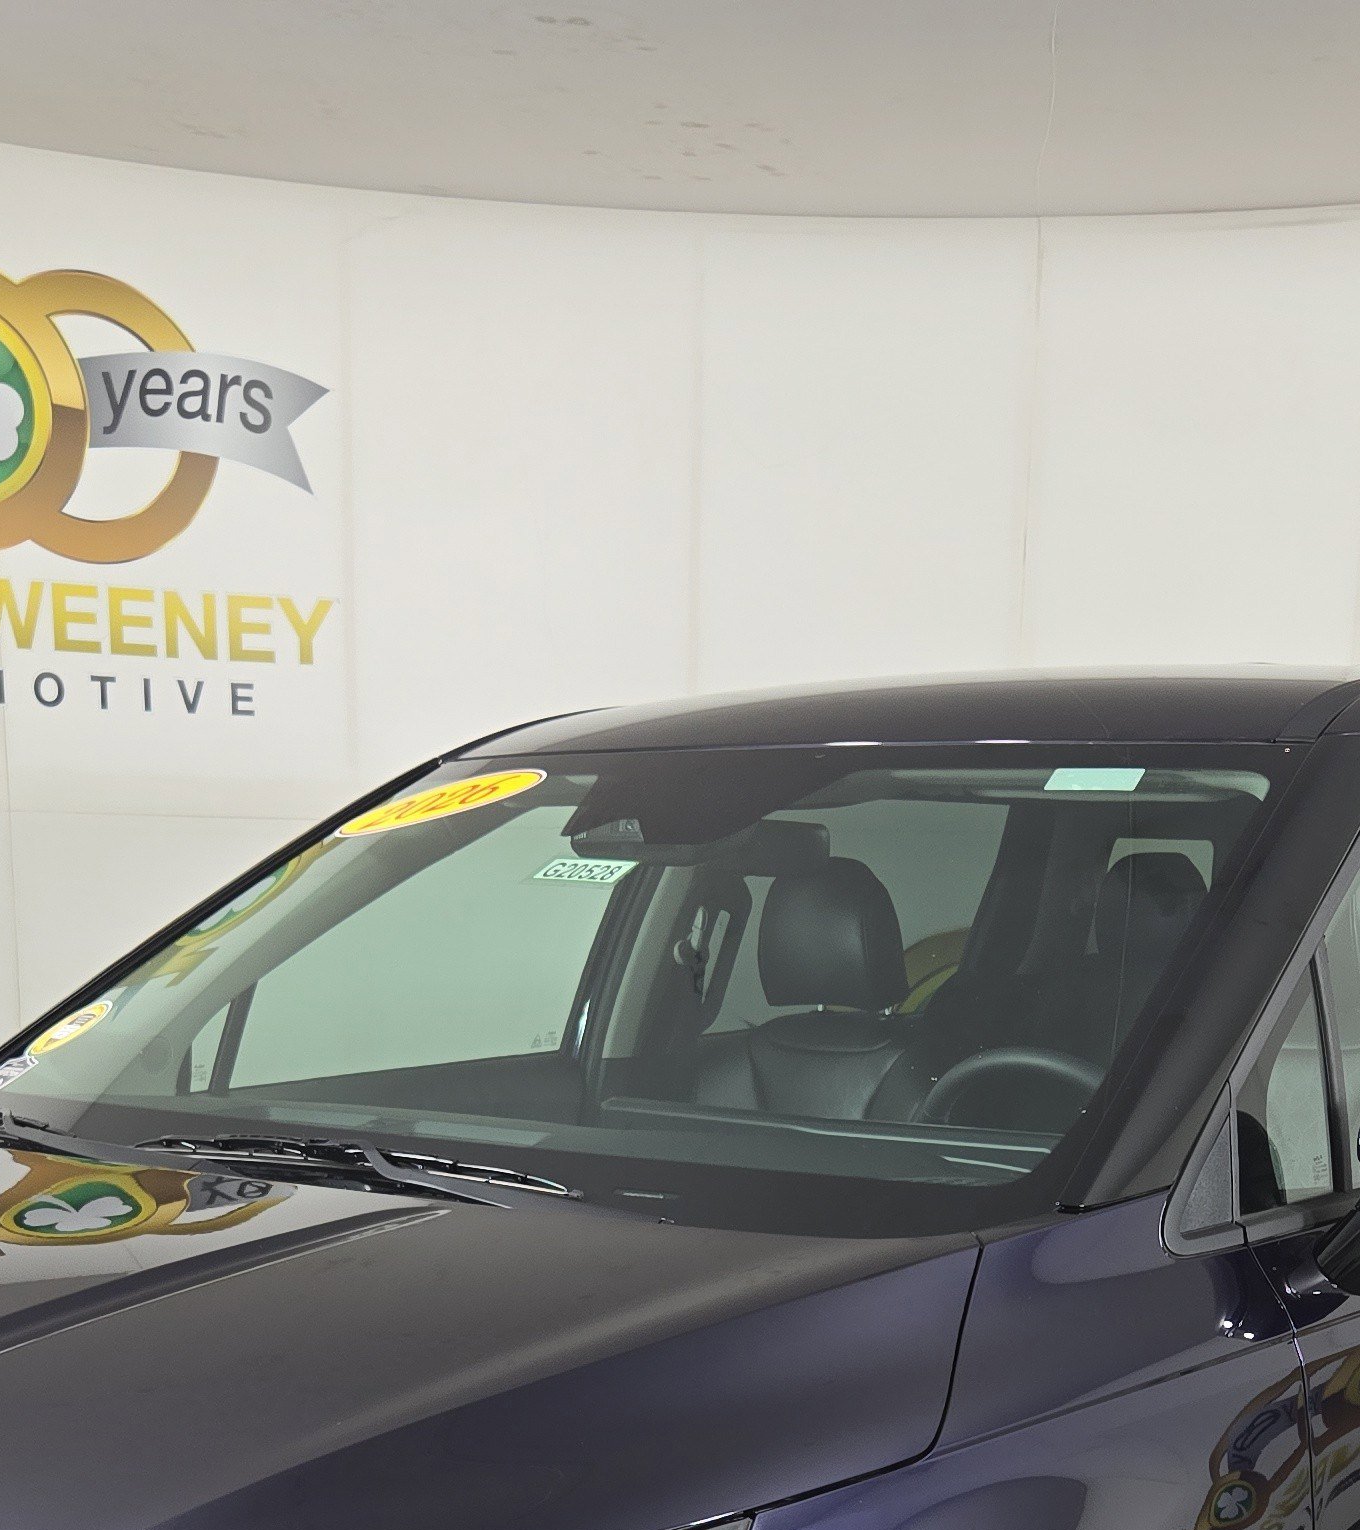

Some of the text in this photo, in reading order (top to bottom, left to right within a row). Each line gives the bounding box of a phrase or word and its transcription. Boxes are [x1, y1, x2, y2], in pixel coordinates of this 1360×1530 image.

[101, 366, 274, 435] years
[357, 774, 522, 831] 2026
[542, 862, 624, 881] G20528
